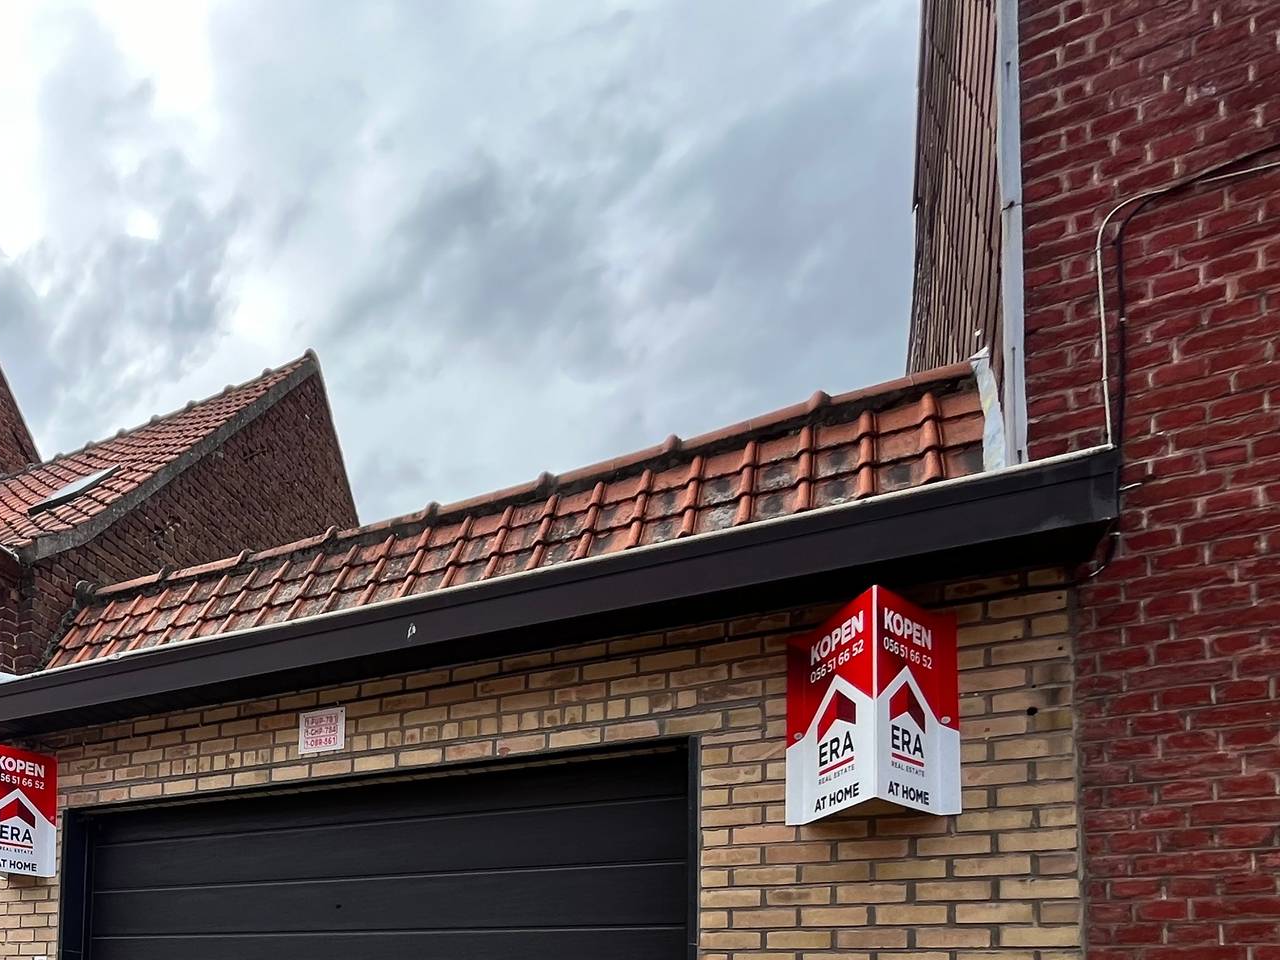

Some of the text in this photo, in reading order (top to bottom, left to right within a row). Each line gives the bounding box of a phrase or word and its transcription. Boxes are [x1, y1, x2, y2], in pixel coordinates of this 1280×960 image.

[810, 610, 864, 666] KOPEN
[883, 607, 932, 650] KOPEN
[810, 639, 864, 684] 056 51 66 52
[883, 636, 932, 670] 056 51 66 52
[818, 731, 854, 767] ERA
[890, 724, 924, 759] ERA
[11, 775, 20, 785] 51
[22, 778, 33, 787] 66
[35, 780, 45, 790] 52
[818, 764, 855, 785] REAL ESTATE
[891, 761, 925, 778] REAL ESTATE
[814, 782, 860, 813] AT HOME
[888, 781, 930, 806] AT HOME
[0, 825, 33, 844] ERA
[9, 860, 37, 872] HOME
